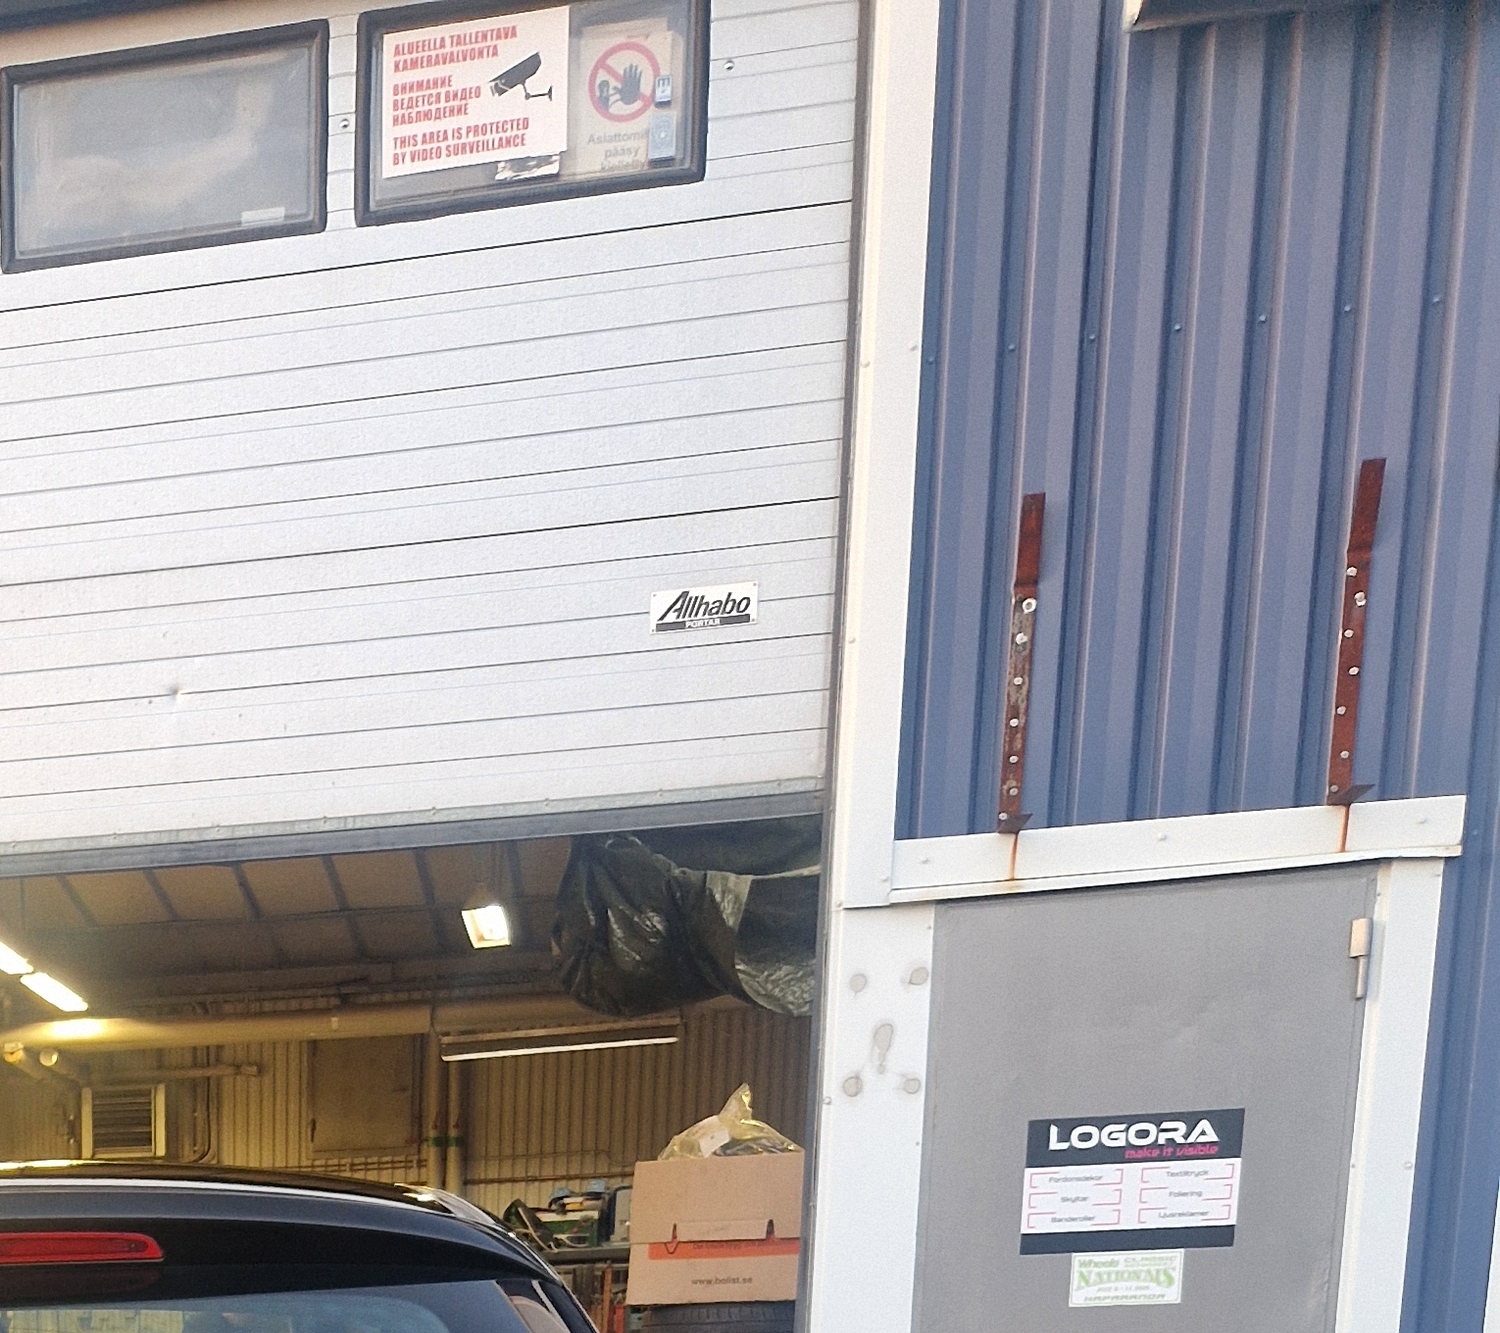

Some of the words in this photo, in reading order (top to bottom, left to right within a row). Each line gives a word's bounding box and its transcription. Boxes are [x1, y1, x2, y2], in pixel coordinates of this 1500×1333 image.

[393, 37, 446, 57] ALUEELLA
[449, 25, 517, 47] TALLENTAVA
[393, 44, 499, 73] KAMERAVALVONTA
[393, 74, 453, 96] ВНИМАНИЕ
[393, 92, 441, 112] ВЕДЕТСЯ
[444, 85, 481, 103] ВИДЕО
[393, 103, 469, 127] НАБЛЮДЕНИЕ
[393, 134, 418, 150] THIS
[421, 129, 449, 146] AREA
[451, 126, 463, 143] IS
[466, 117, 530, 139] PROTECTED
[392, 152, 407, 166] BY
[409, 146, 442, 163] VIDEO
[445, 133, 527, 157] SURVEILLANCE
[657, 590, 751, 621] Allhabo
[1048, 1118, 1220, 1151] LOGORA
[1124, 1147, 1160, 1159] make
[1162, 1145, 1175, 1157] it
[1176, 1143, 1219, 1156] visible
